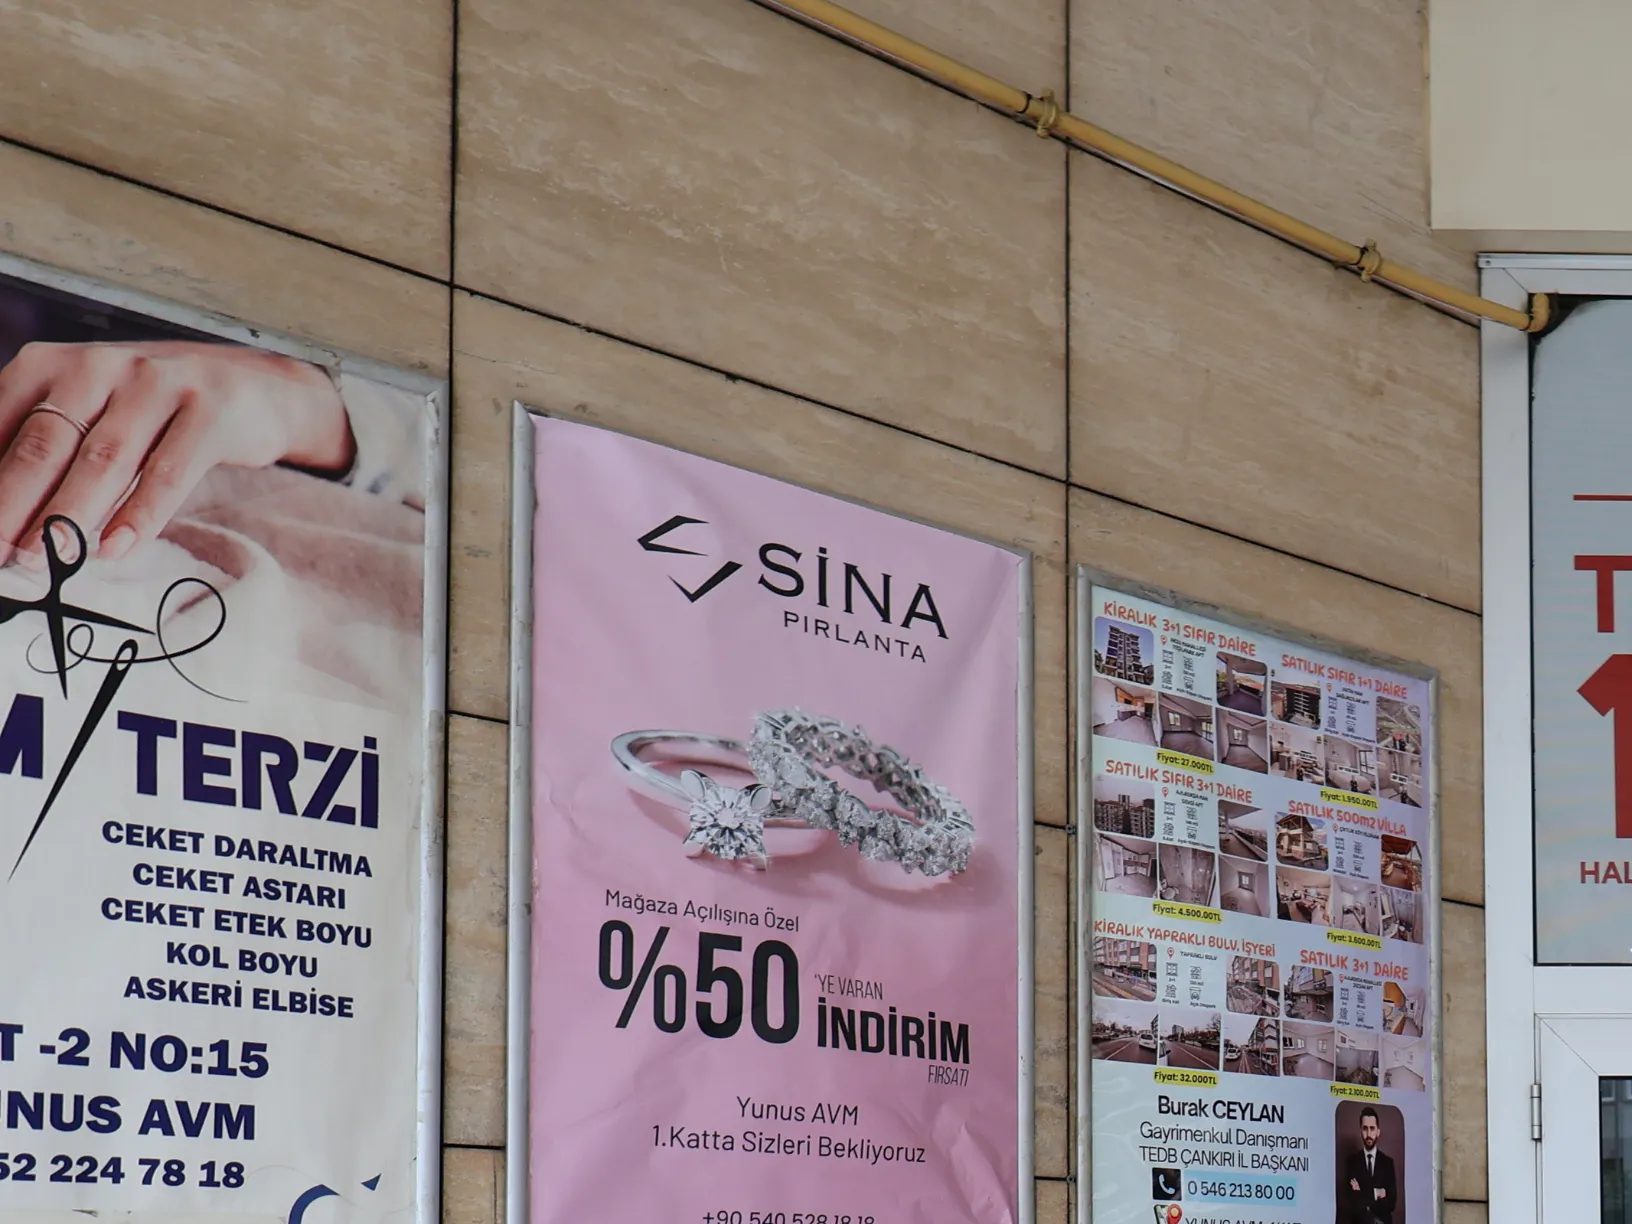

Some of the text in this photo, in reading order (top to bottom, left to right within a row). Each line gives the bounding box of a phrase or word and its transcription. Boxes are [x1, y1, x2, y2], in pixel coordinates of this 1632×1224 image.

[757, 542, 949, 640] SİNA
[783, 611, 927, 663] PIRLANTA
[1103, 601, 1157, 629] KİRALIK
[1162, 618, 1180, 635] 3+1
[1183, 625, 1217, 646] SIFIR
[1218, 634, 1256, 657] DAİRE
[1282, 653, 1325, 678] SATILIK
[1327, 667, 1355, 685] SIFIR
[1358, 676, 1372, 690] 1+1
[1375, 679, 1408, 699] DAİRE
[117, 709, 379, 829] TERZİ
[1106, 759, 1158, 782] SATILIK
[1162, 770, 1194, 790] SIFIR
[1196, 776, 1215, 793] 3+1
[1216, 780, 1253, 803] DAİRE
[1157, 752, 1214, 773] Fiyat: 27.000TL
[1320, 790, 1341, 802] Fiyat:
[1288, 800, 1334, 822] SATILIK
[1378, 816, 1407, 836] VİLLA
[102, 820, 372, 877] CEKET DARALTMA
[133, 862, 346, 909] CEKET ASTARI
[101, 897, 372, 948] CEKET ETEK BOYU
[605, 889, 799, 932] Mağaza Açılışına Özel
[1152, 902, 1176, 917] Fiyat:
[1094, 920, 1144, 937] KİRALIK
[1147, 927, 1206, 946] YAPRAKLI
[1242, 938, 1276, 957] İŞYERİ
[1327, 931, 1347, 943] Fiyat:
[166, 941, 318, 978] KOL BOYU
[1300, 949, 1409, 981] SATILIK 3+1 DAİRE
[124, 976, 354, 1018] ASKERİ ELBİSE
[598, 920, 800, 1044] %50
[838, 977, 883, 1001] VARAN
[817, 997, 970, 1065] İNDİRİM
[40, 1027, 90, 1066] -2
[110, 1031, 270, 1079] NO:15
[928, 1065, 969, 1087] FIRSATI
[1154, 1071, 1217, 1085] Fiyat: 32.000TL
[1330, 1085, 1347, 1096] Fiyat:
[0, 1090, 256, 1141] NUS AVM
[737, 1096, 859, 1126] Yunus AVM
[1158, 1095, 1284, 1123] Burak CEYLAN
[652, 1124, 926, 1166] 1.Katta Sizleri Bekliyoruz
[1140, 1121, 1309, 1151] Gayrimenkul Danışmanı
[49, 1154, 125, 1184] 224
[138, 1159, 186, 1187] 78
[199, 1161, 246, 1189] 18
[1139, 1145, 1309, 1174] TEDB ÇANKIRI İL BAŞKANI
[1188, 1180, 1295, 1201] 0 546 213 80 00
